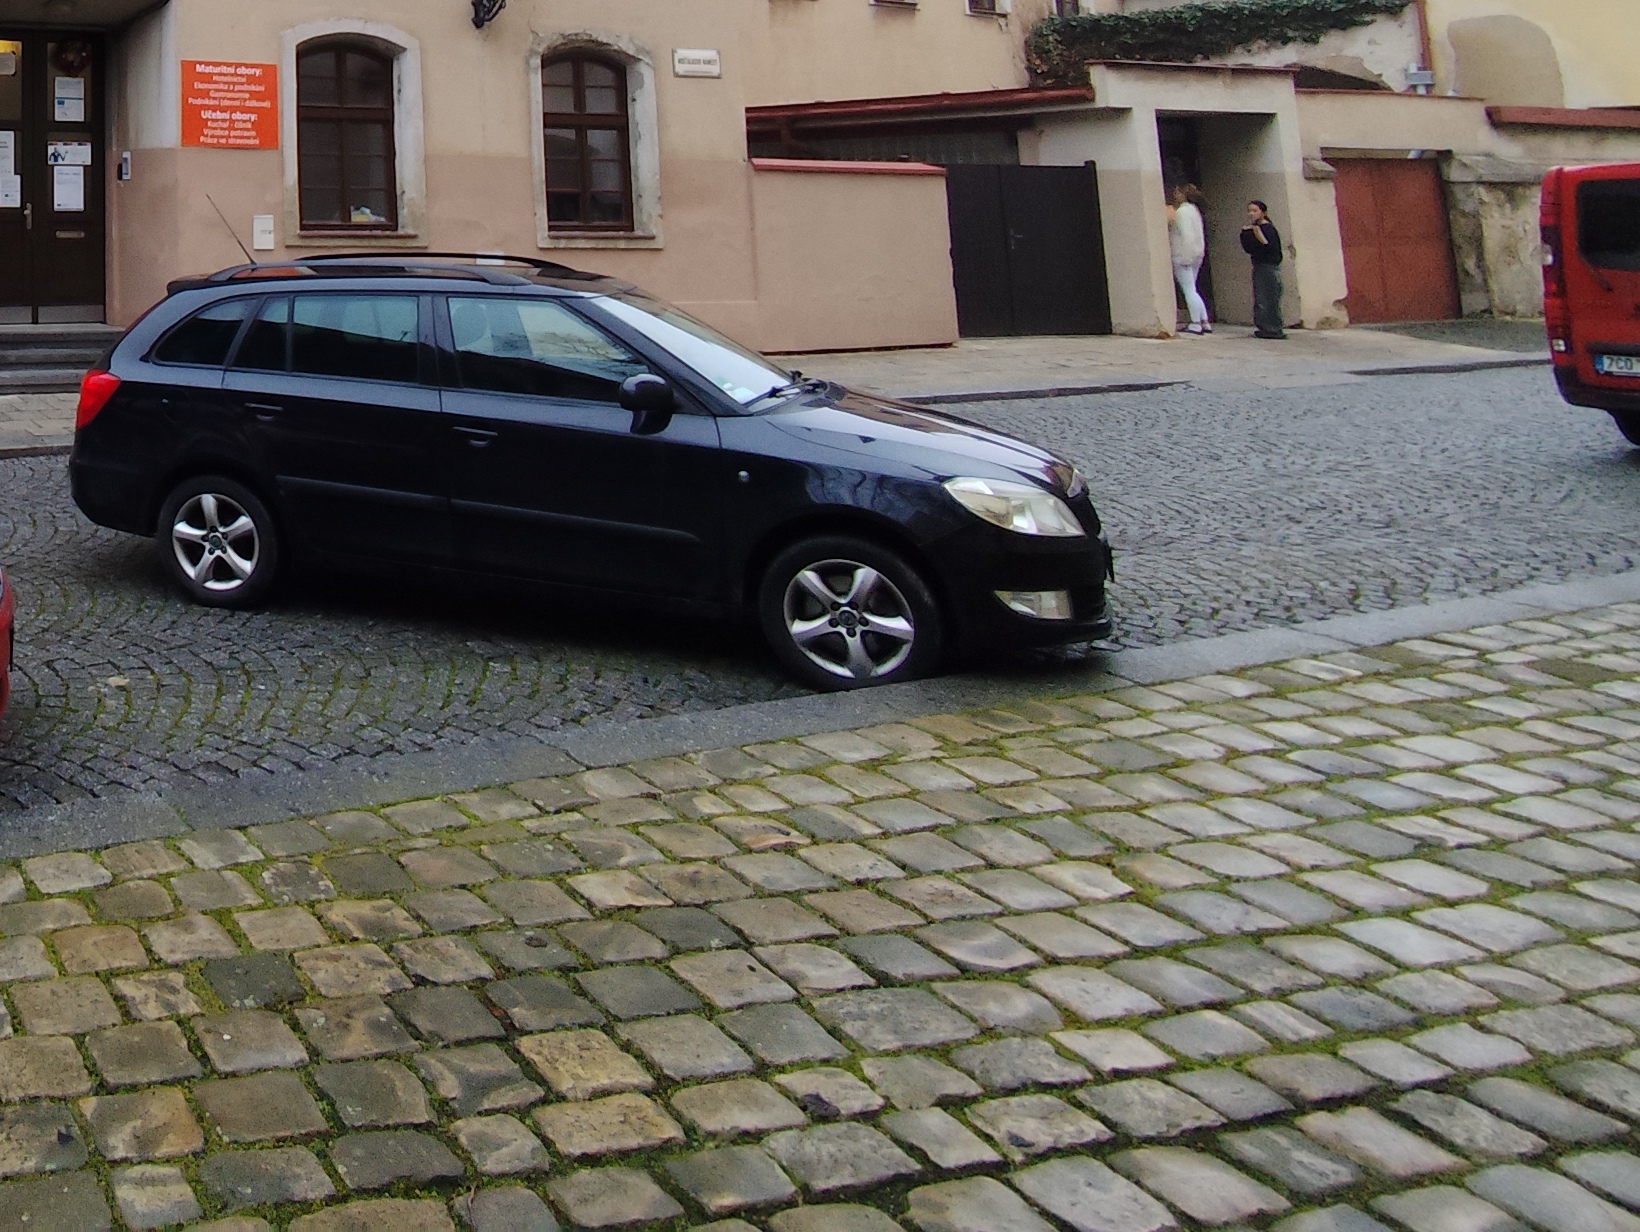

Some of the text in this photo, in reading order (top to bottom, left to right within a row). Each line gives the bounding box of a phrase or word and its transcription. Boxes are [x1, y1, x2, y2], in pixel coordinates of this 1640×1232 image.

[196, 64, 262, 76] Maturitní obory:
[201, 110, 258, 122] Učební obory:
